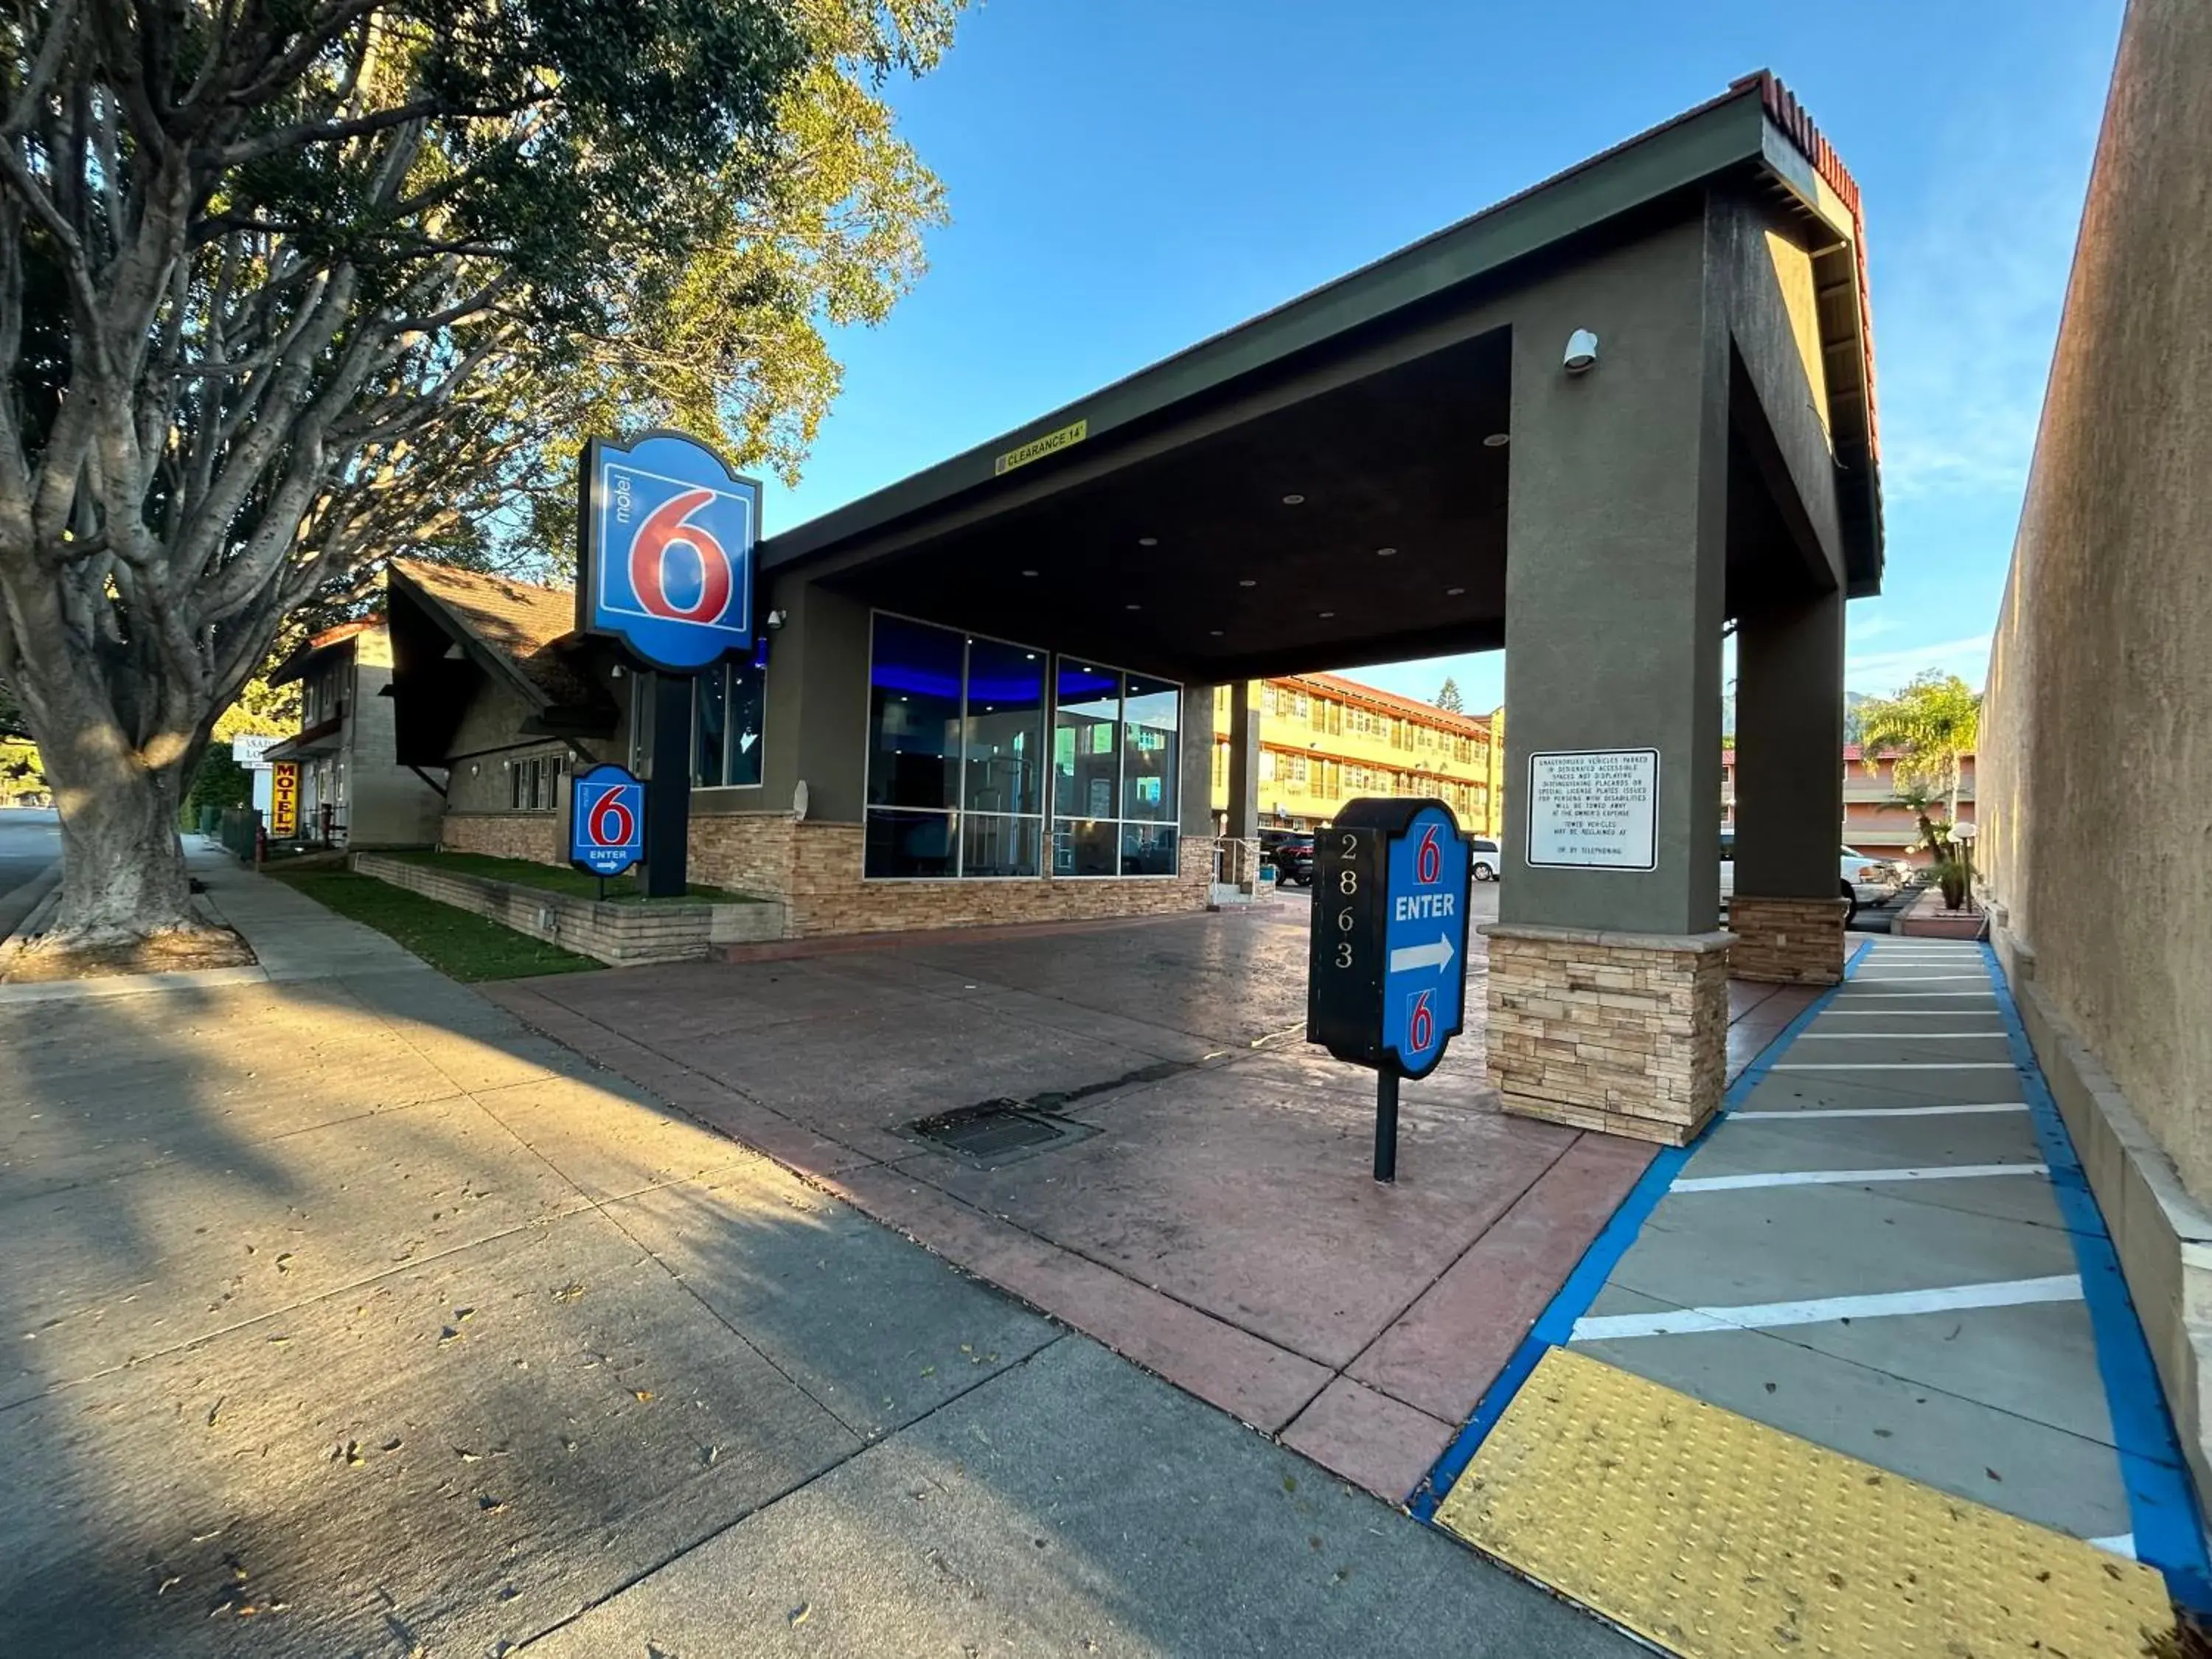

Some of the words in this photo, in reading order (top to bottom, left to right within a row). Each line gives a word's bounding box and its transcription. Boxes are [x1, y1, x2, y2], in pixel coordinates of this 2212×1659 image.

[1007, 433, 1065, 467] CLEARANCE
[613, 474, 632, 524] motel
[628, 489, 734, 625] 6
[276, 765, 294, 824] MOTEL
[588, 784, 635, 847] 6
[1417, 823, 1441, 885] 6
[1395, 892, 1455, 922] ENTER
[1410, 990, 1433, 1053] 6
